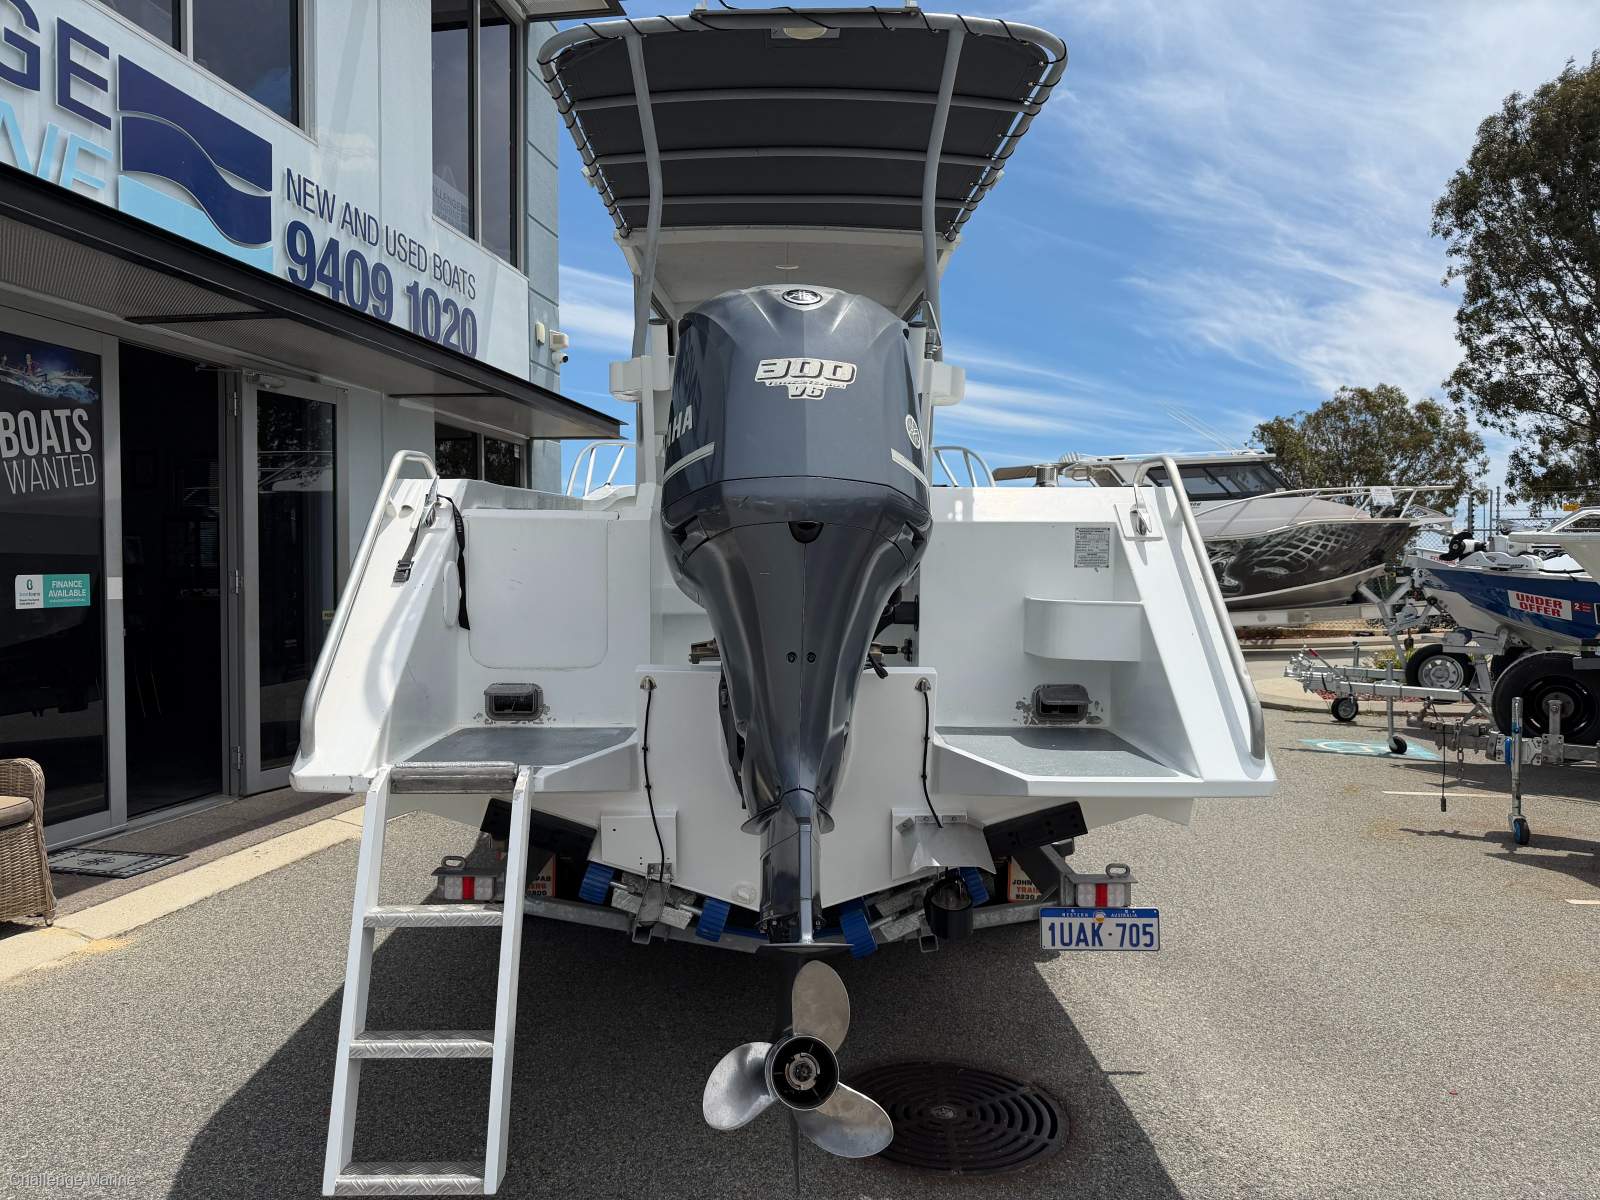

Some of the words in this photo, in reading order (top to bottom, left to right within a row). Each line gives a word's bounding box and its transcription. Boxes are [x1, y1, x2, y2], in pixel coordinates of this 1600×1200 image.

[286, 167, 336, 224] NEW
[340, 202, 380, 247] AND
[385, 225, 428, 273] USED
[433, 252, 477, 301] BOATS
[286, 219, 395, 323] 9409
[405, 280, 478, 358] 1020
[756, 358, 857, 382] 300
[789, 385, 824, 398] V6
[0, 408, 92, 458] BOATS
[3, 453, 97, 494] WANTED
[48, 589, 87, 598] AVAILABLE
[51, 580, 84, 588] FINANCE
[1515, 592, 1563, 609] UNDER
[1519, 601, 1561, 617] OFFER
